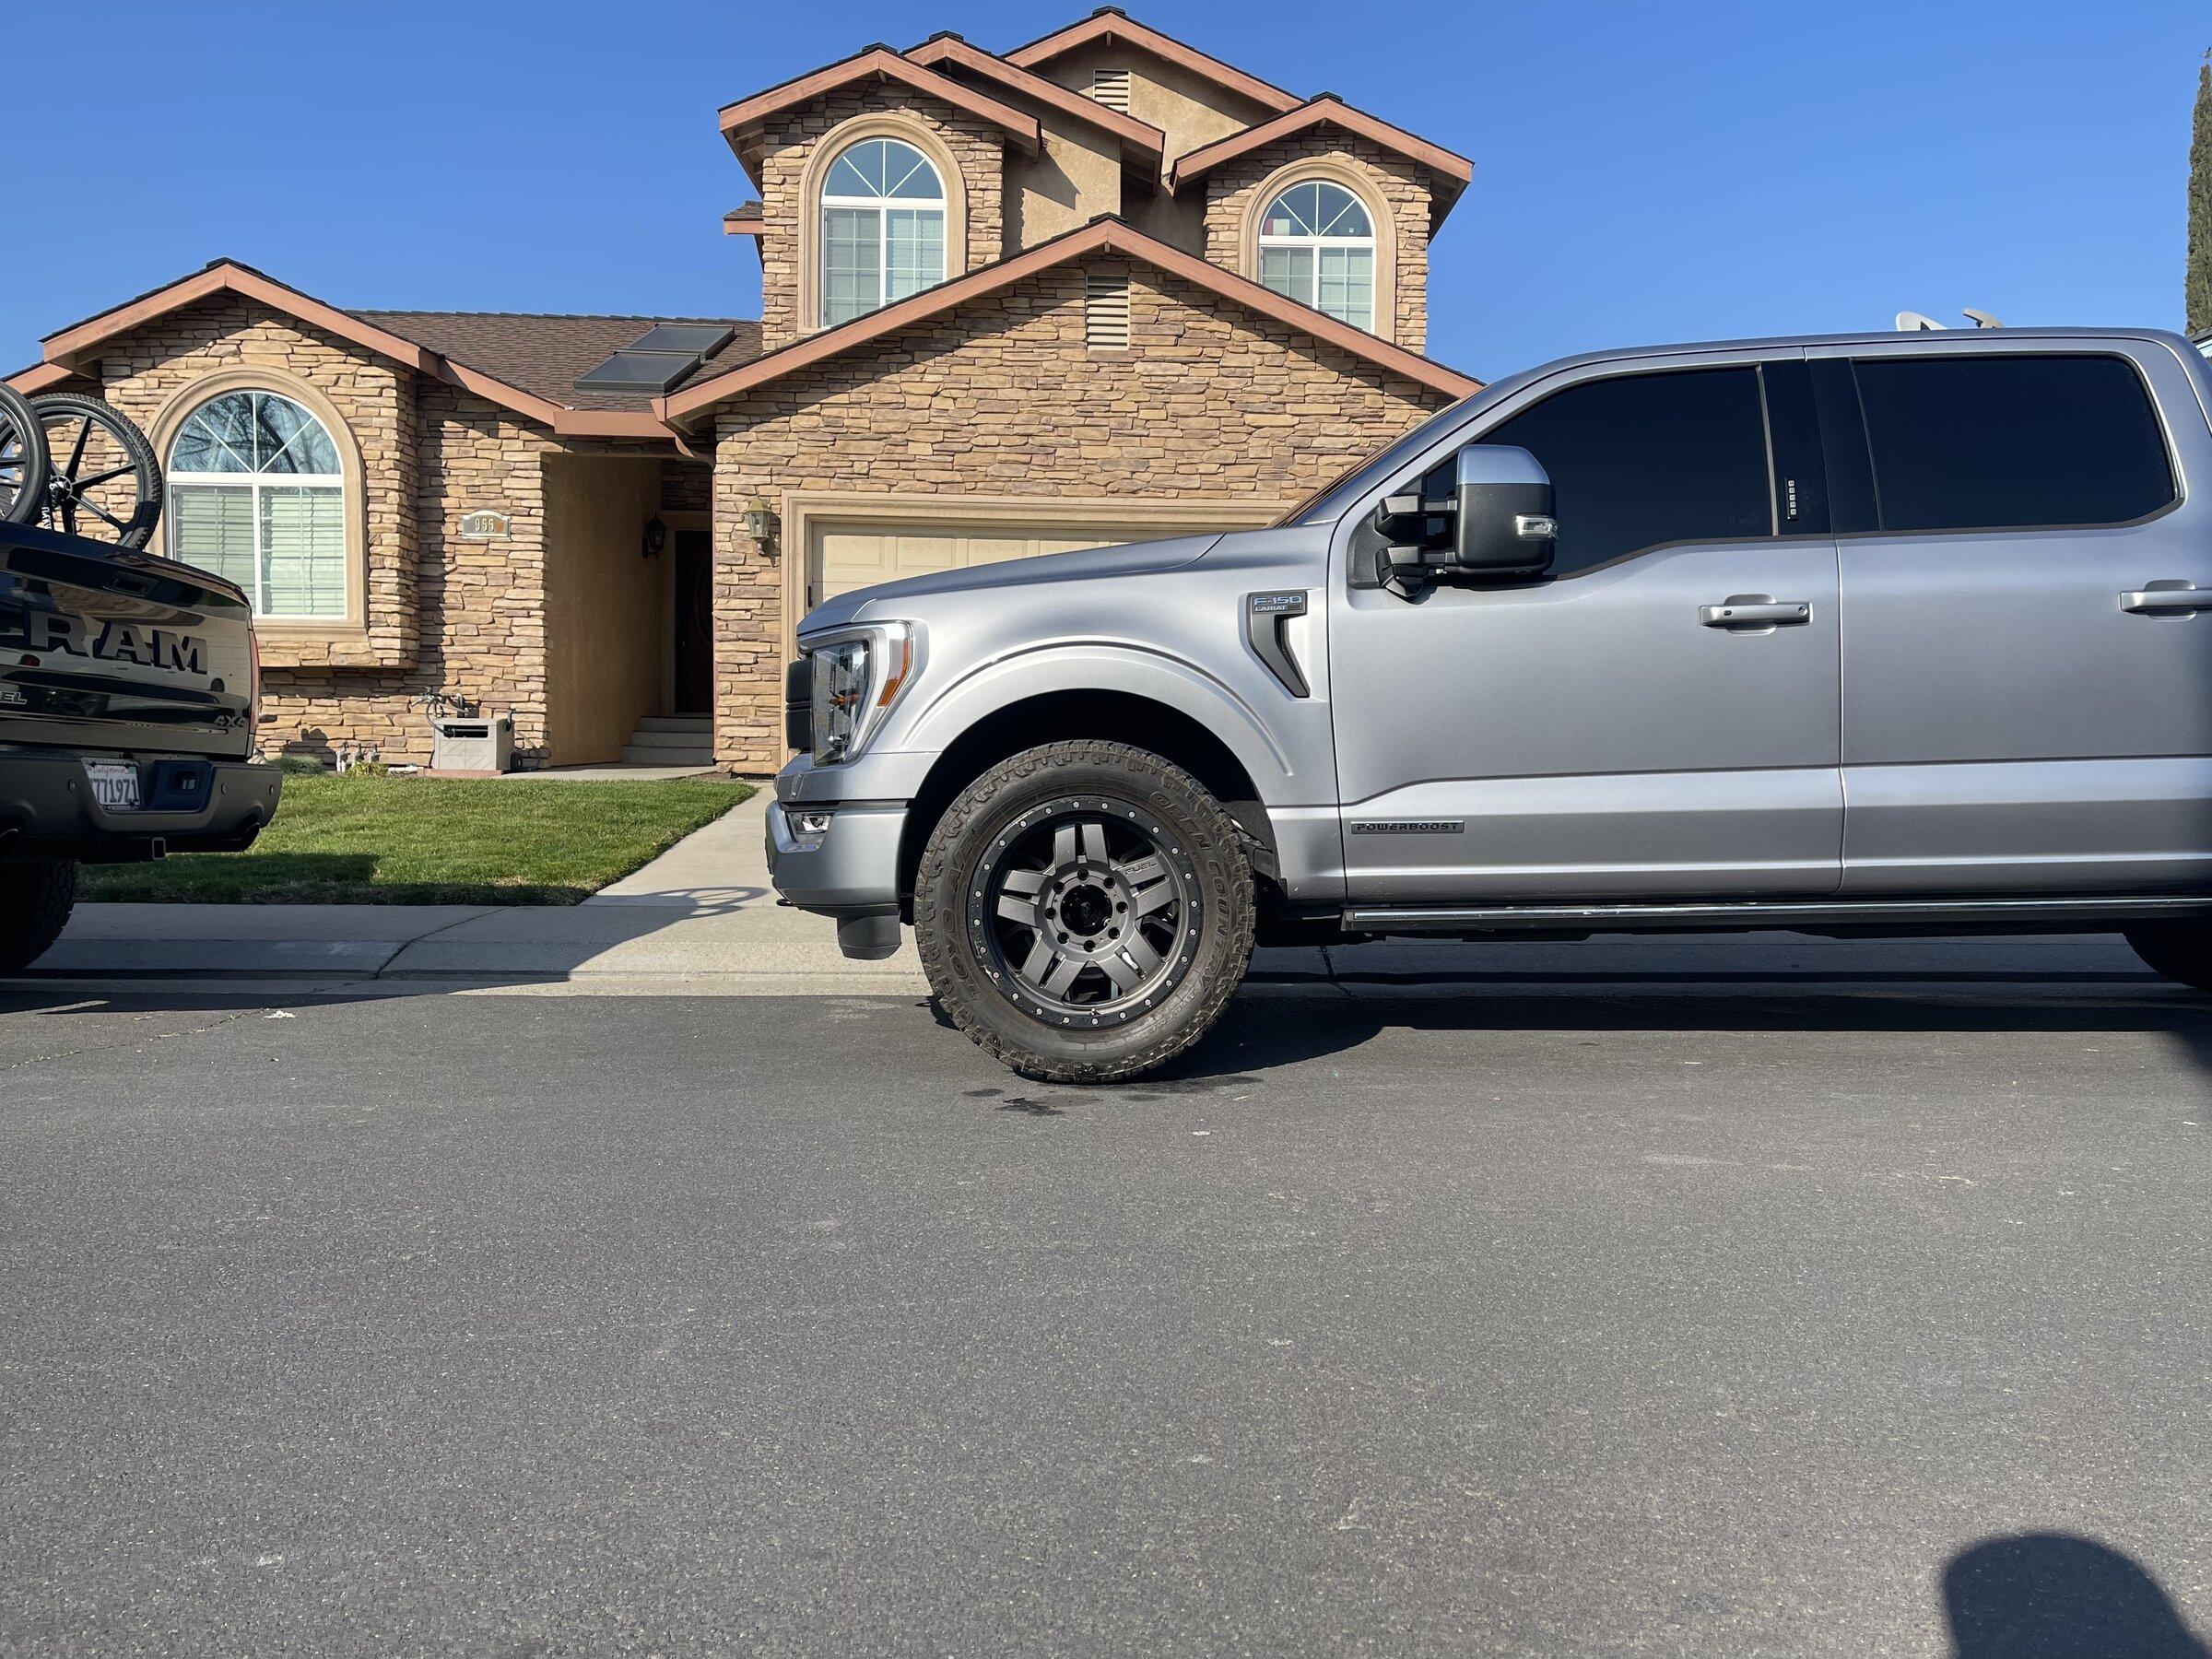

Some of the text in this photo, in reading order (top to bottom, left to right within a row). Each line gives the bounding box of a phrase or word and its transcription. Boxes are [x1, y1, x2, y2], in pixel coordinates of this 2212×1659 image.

[1254, 595, 1302, 606] F-150
[26, 609, 208, 675] RAM
[1357, 822, 1459, 830] POWERBOOST
[1125, 862, 1158, 875] FUEL
[1150, 791, 1231, 992] OPEN COUNTRY
